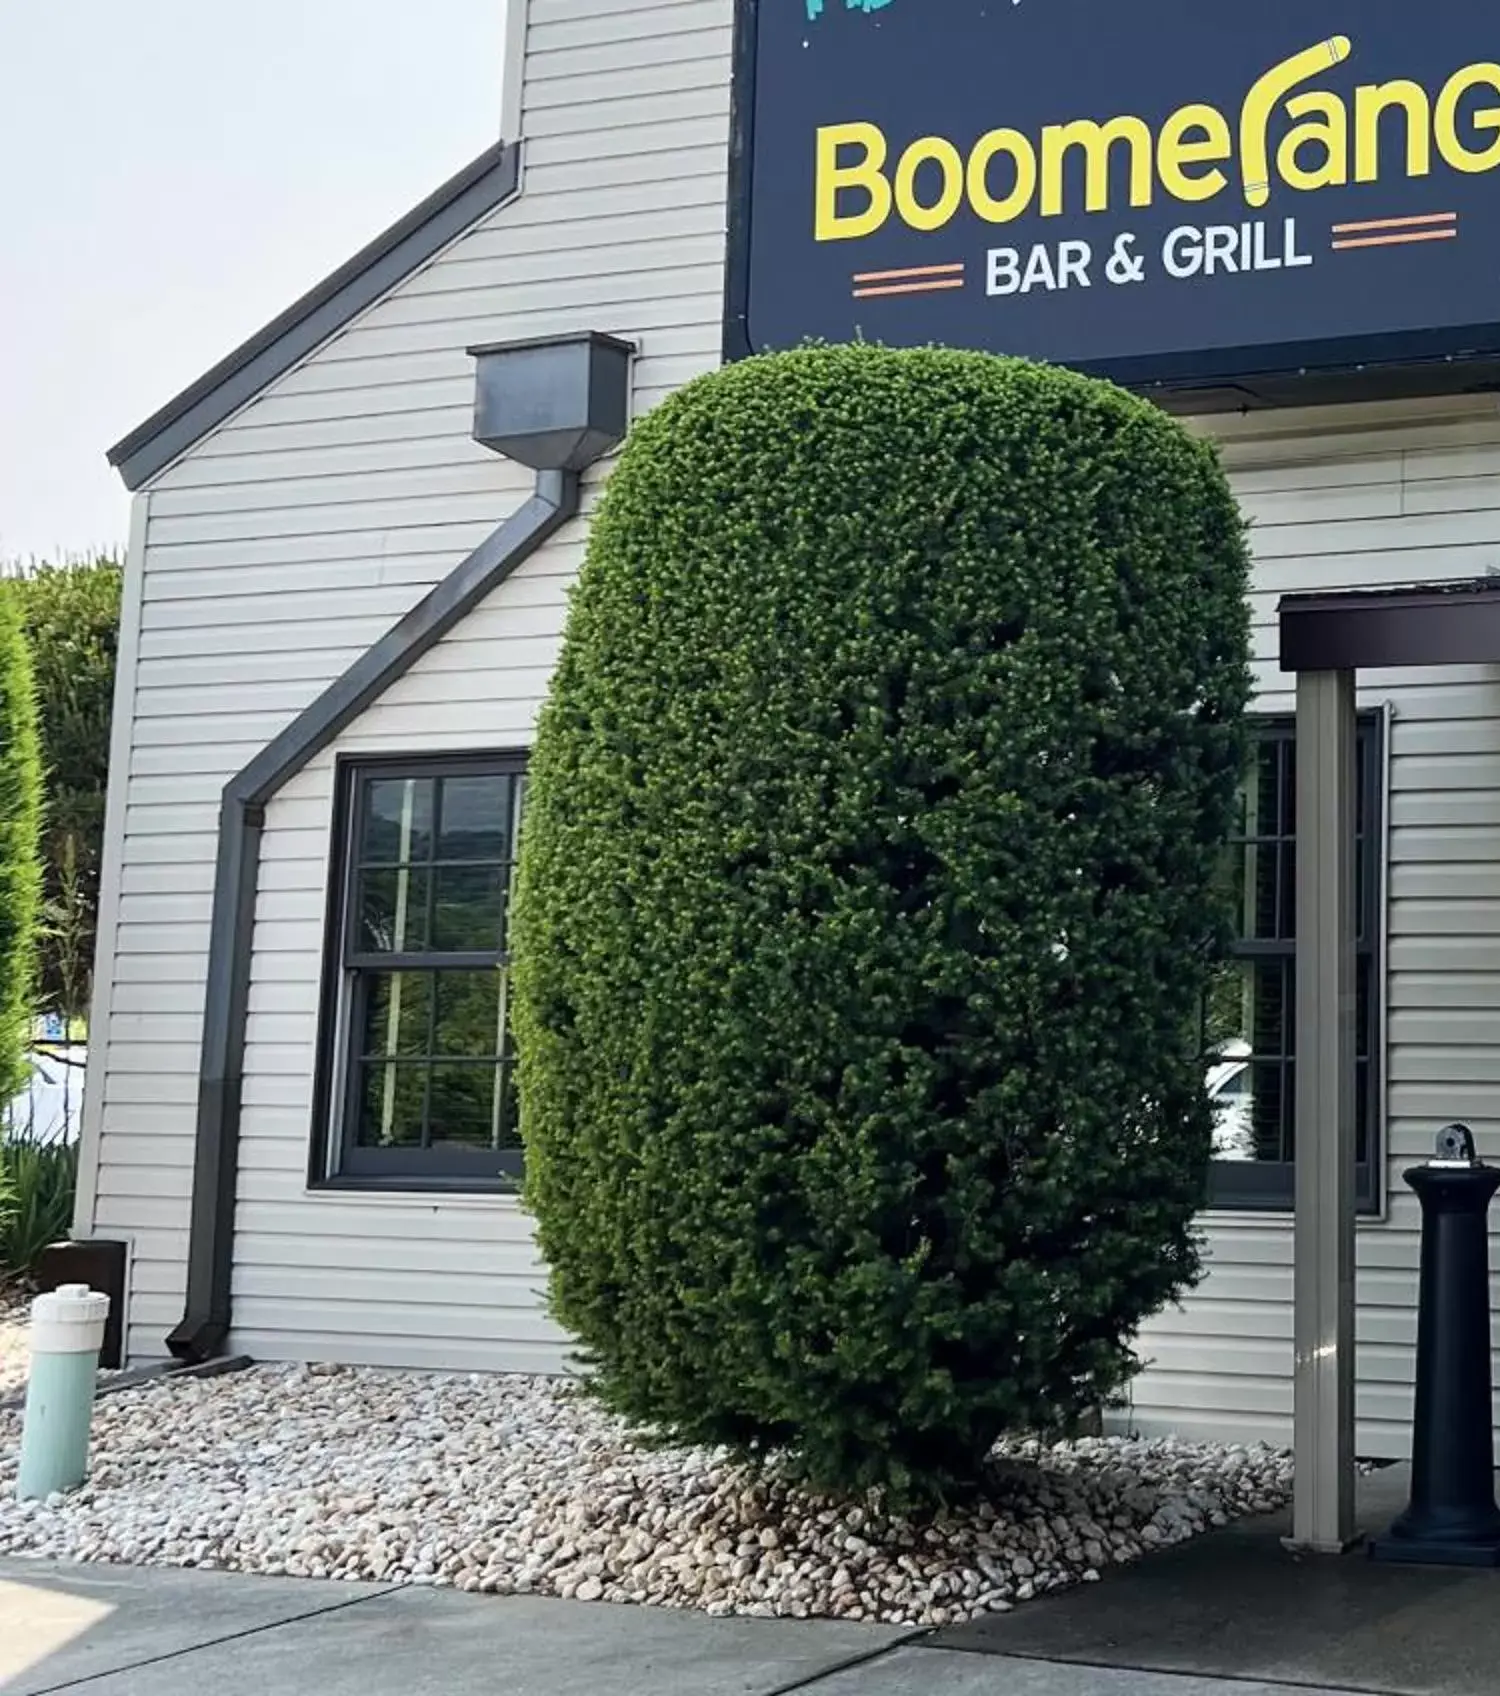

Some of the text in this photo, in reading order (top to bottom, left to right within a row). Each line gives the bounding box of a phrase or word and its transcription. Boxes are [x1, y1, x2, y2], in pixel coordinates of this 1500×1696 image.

[985, 217, 1313, 297] BAR & GRILL
